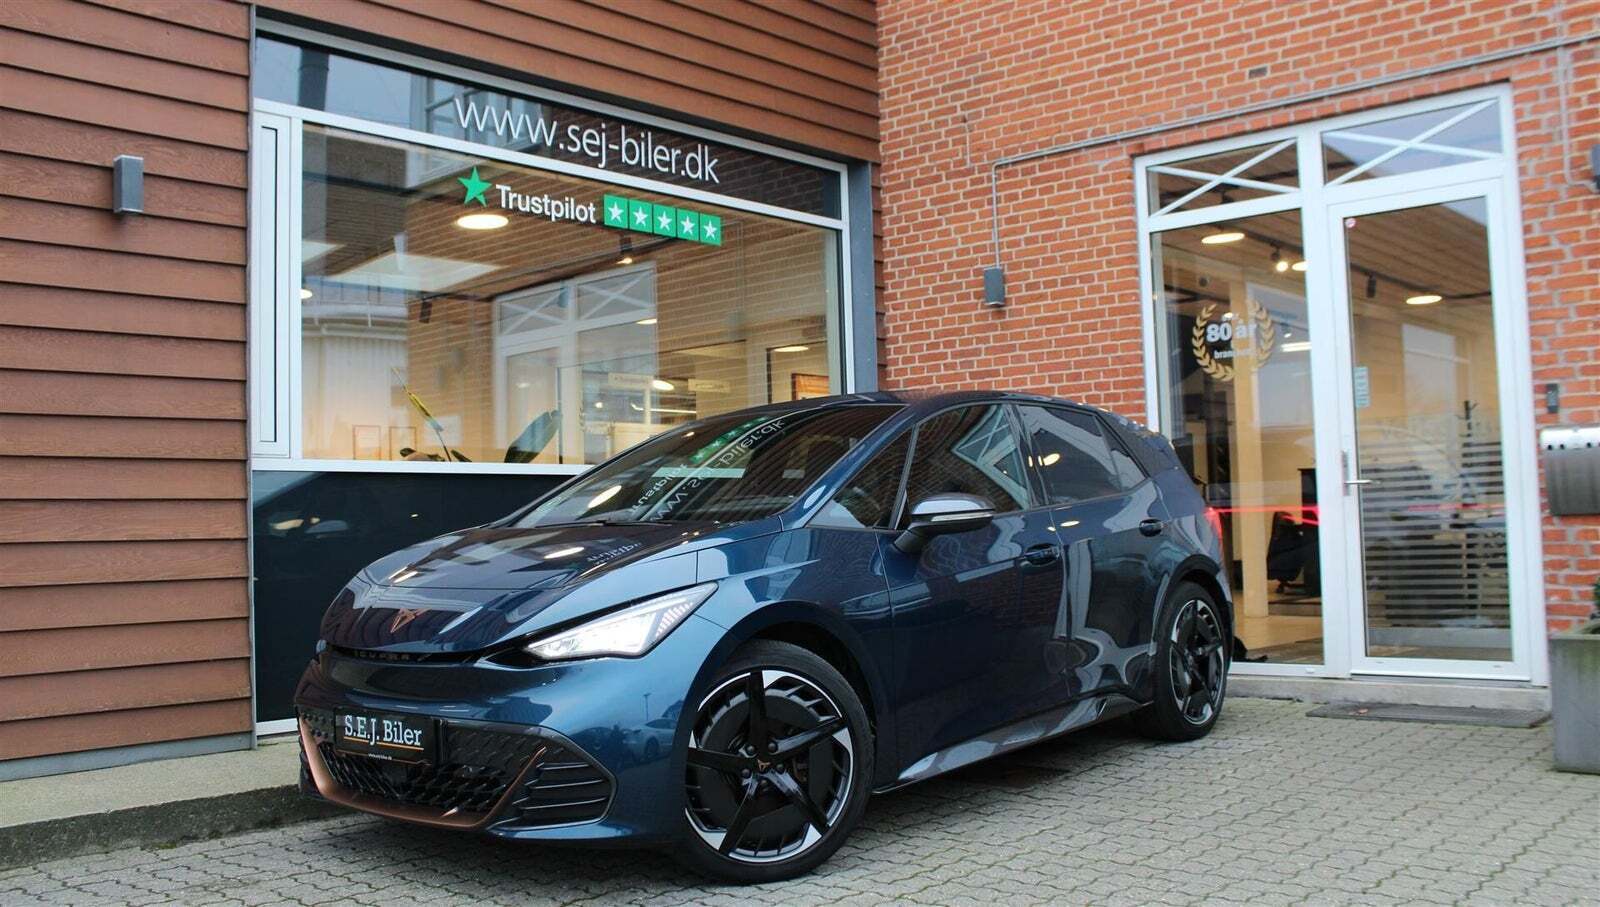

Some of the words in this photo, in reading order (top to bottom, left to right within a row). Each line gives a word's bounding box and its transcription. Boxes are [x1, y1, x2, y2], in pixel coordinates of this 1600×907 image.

[455, 98, 720, 184] www.sej-biler.dk
[495, 184, 597, 224] Trustpilot
[1206, 322, 1232, 342] 80
[344, 714, 380, 746] S.E.J.
[382, 719, 423, 746] Biler
